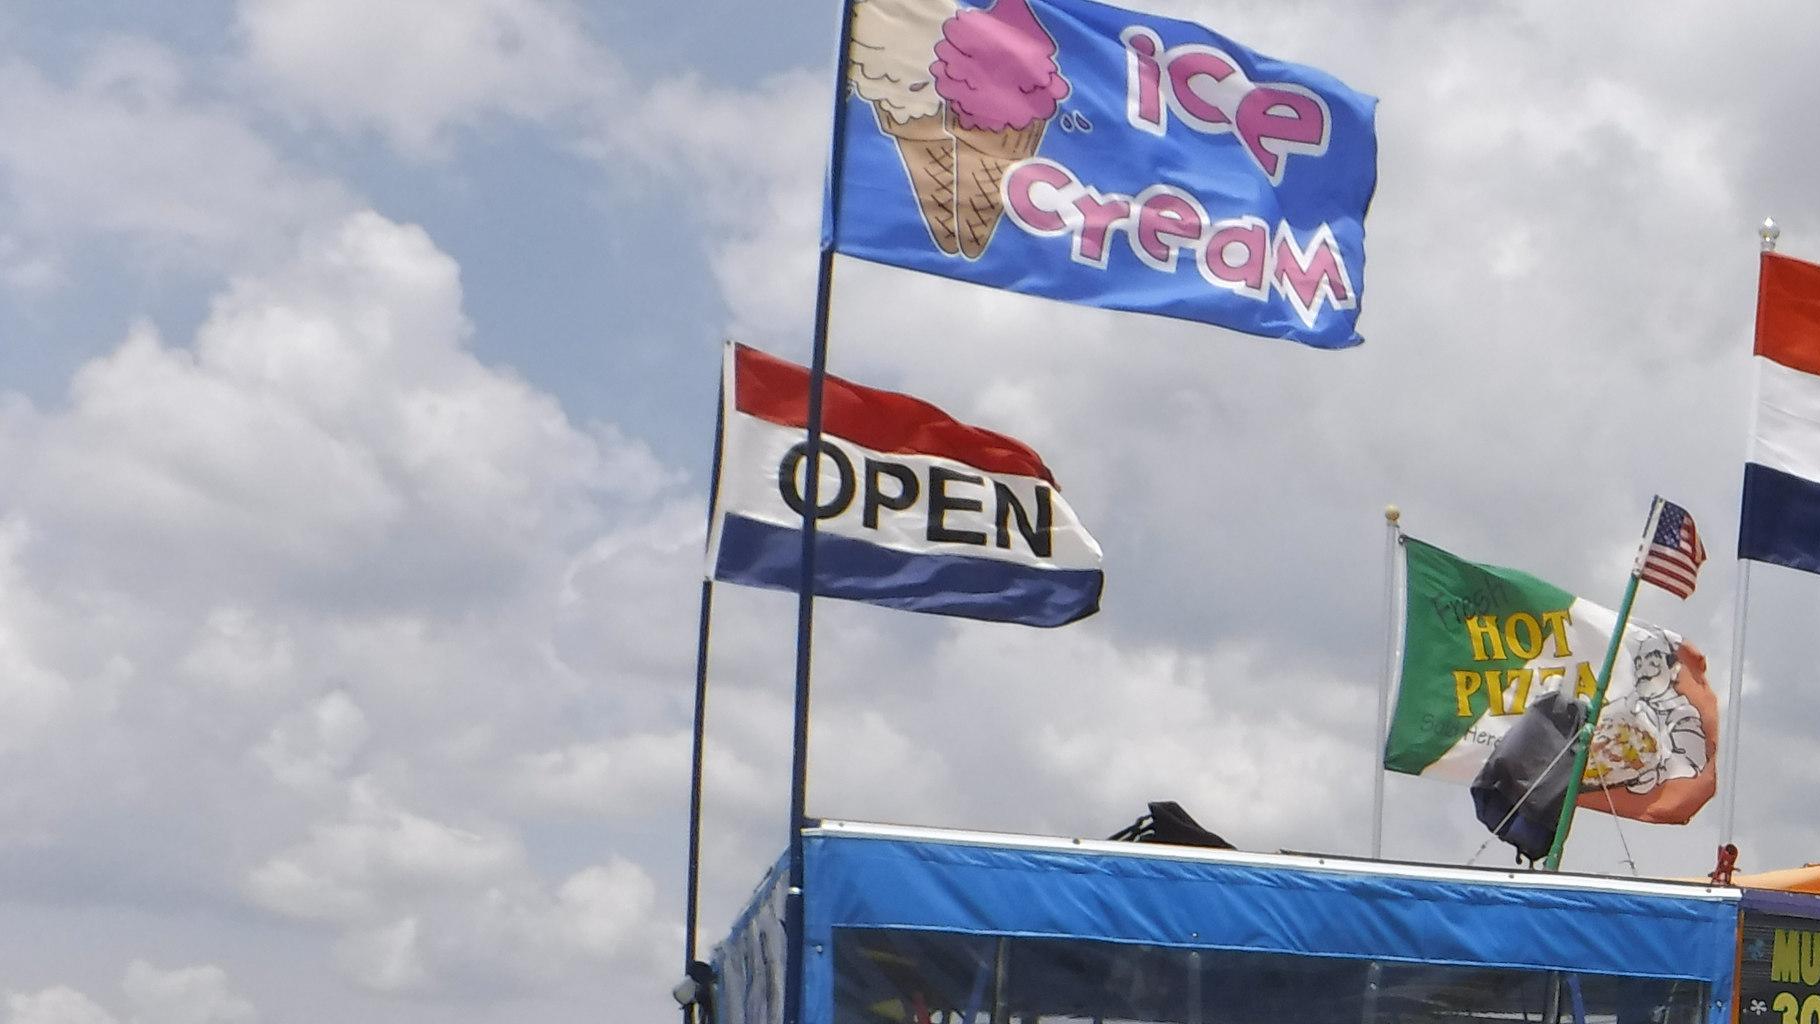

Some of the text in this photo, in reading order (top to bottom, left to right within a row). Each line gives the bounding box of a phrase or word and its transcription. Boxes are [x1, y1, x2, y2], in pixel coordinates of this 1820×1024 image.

[1121, 25, 1332, 186] ice
[778, 439, 1053, 558] OPEN
[1465, 609, 1573, 661] HOT
